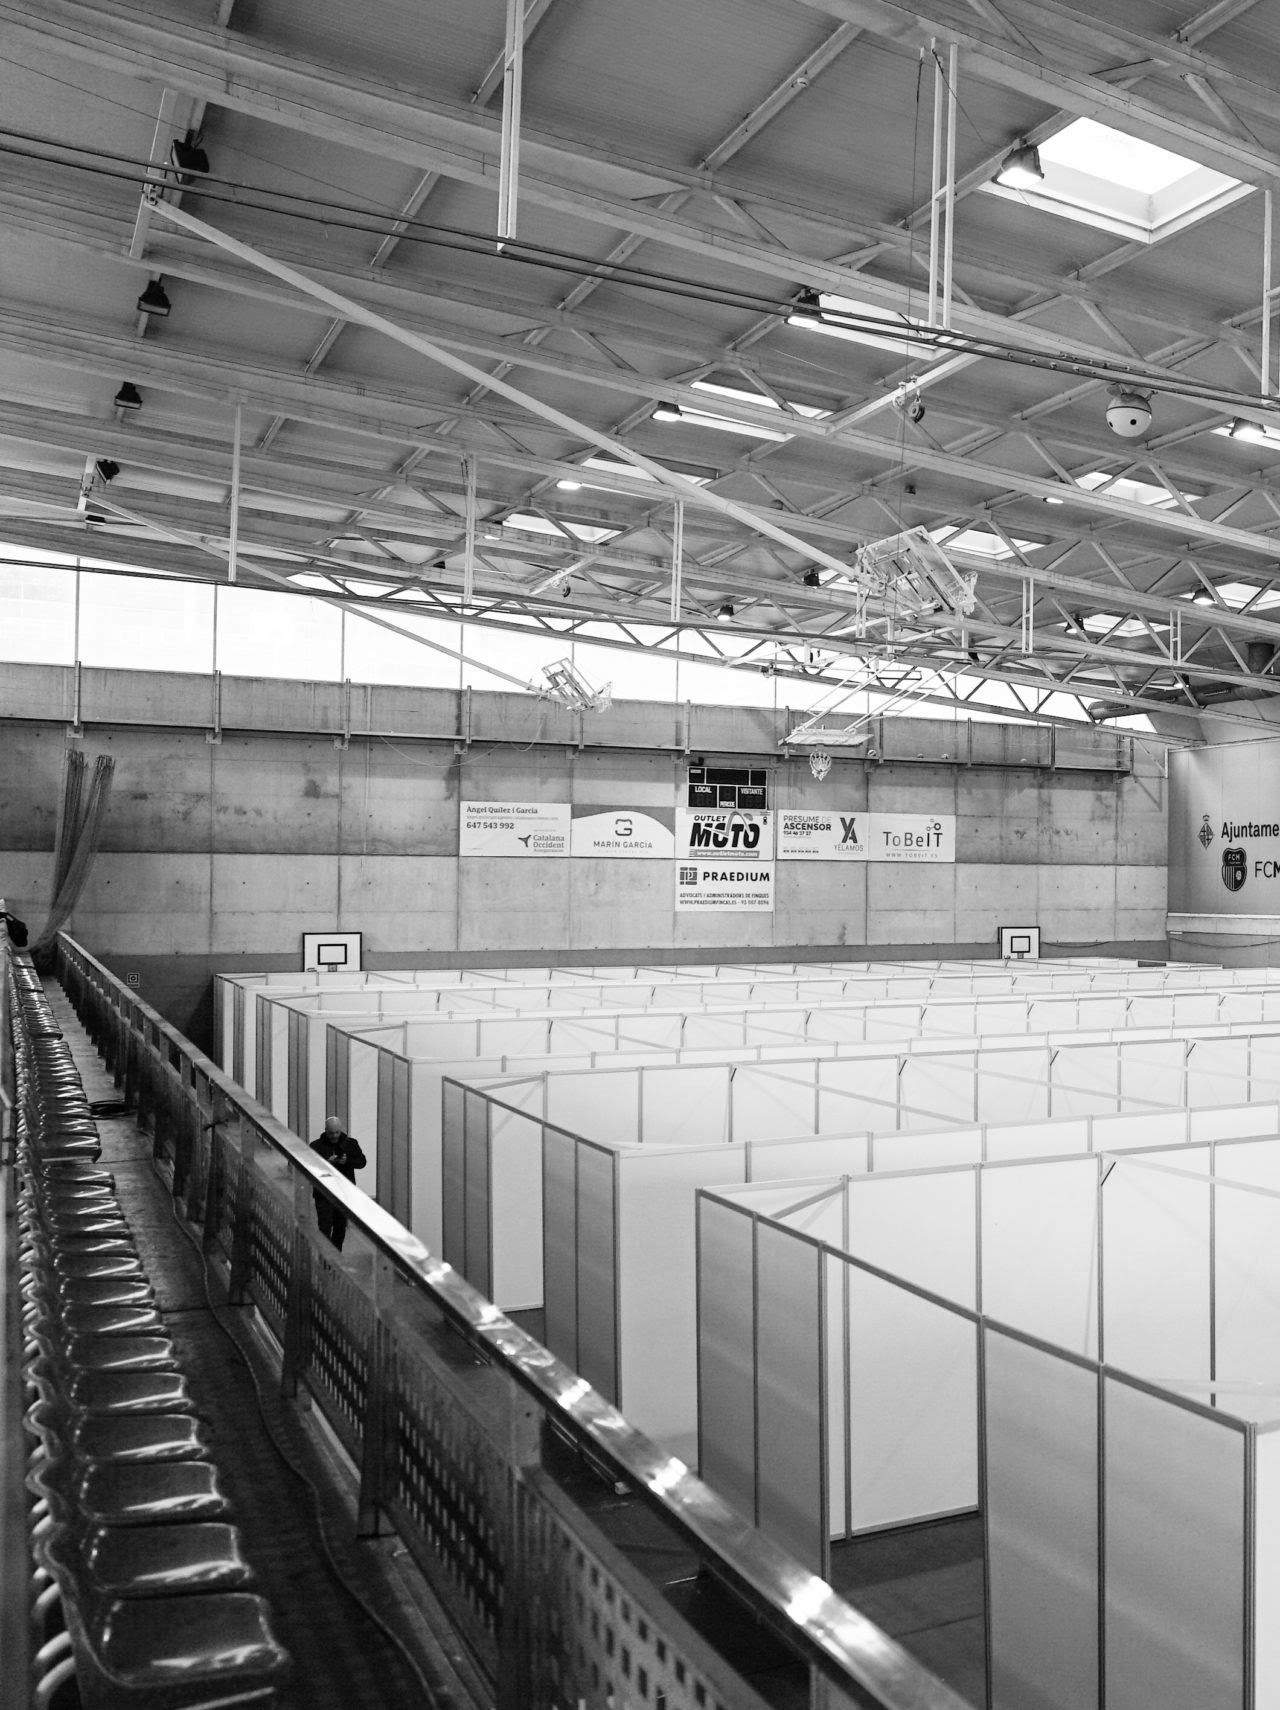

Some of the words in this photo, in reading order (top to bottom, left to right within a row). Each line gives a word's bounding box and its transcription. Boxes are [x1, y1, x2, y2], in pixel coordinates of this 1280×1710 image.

[783, 815, 820, 823] PRESUME
[466, 821, 481, 829] 647
[499, 822, 515, 830] 992
[783, 822, 832, 831] ASCENSOR
[689, 822, 761, 848] MOTO
[703, 872, 770, 882] PRAEDIUM
